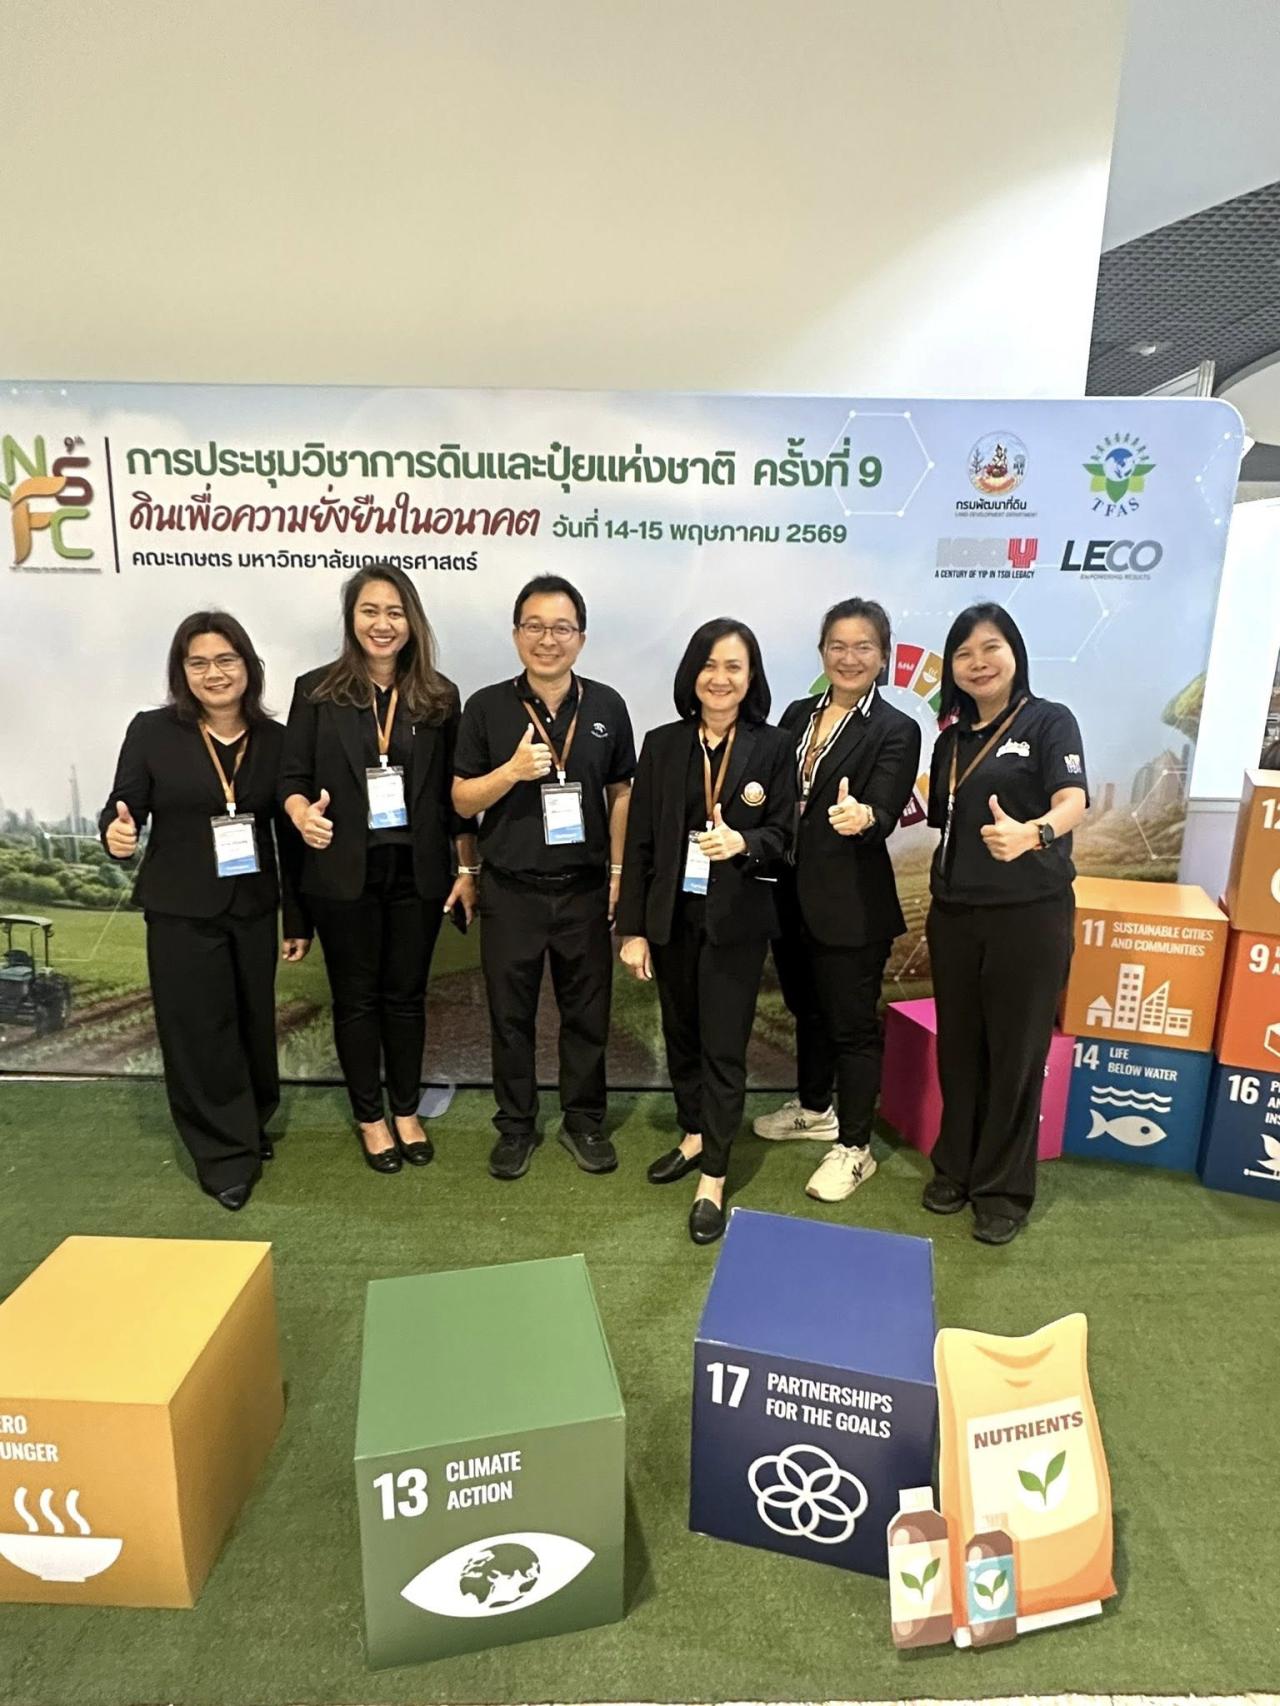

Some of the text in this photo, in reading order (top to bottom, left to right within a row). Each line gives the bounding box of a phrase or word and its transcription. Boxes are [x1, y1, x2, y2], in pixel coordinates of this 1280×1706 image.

[127, 437, 883, 494] การประชุมวิชาการดินและปุ๋ยแห่งชาติ ครั้งที่ 9
[130, 482, 541, 537] ดินเพื่อความยั่งยืนในอนาคต
[1091, 496, 1140, 517] TFAS
[552, 508, 848, 546] วันที่ 14-15 พฤษภาคม 2569
[132, 550, 233, 568] คณะเกษตร
[1060, 539, 1163, 573] LECO
[941, 569, 968, 579] CENTURY
[1082, 918, 1106, 947] 11
[1112, 921, 1214, 941] SUSTAINABLE CITIES
[1111, 937, 1206, 957] AND COMMUNITIES
[1248, 943, 1270, 973] 9
[1072, 1042, 1100, 1071] 14
[1109, 1047, 1130, 1060] LIFE
[1107, 1061, 1178, 1082] BELOW WATER
[1228, 1074, 1260, 1104] 16
[706, 1362, 750, 1408] 17
[766, 1372, 893, 1414] PARTNERSHIPS
[765, 1397, 891, 1439] FOR THE GOALS
[973, 1410, 1084, 1450] NUTRIENTS
[445, 1450, 522, 1482] CLIMATE
[373, 1468, 429, 1521] 13
[446, 1480, 513, 1511] ACTION
